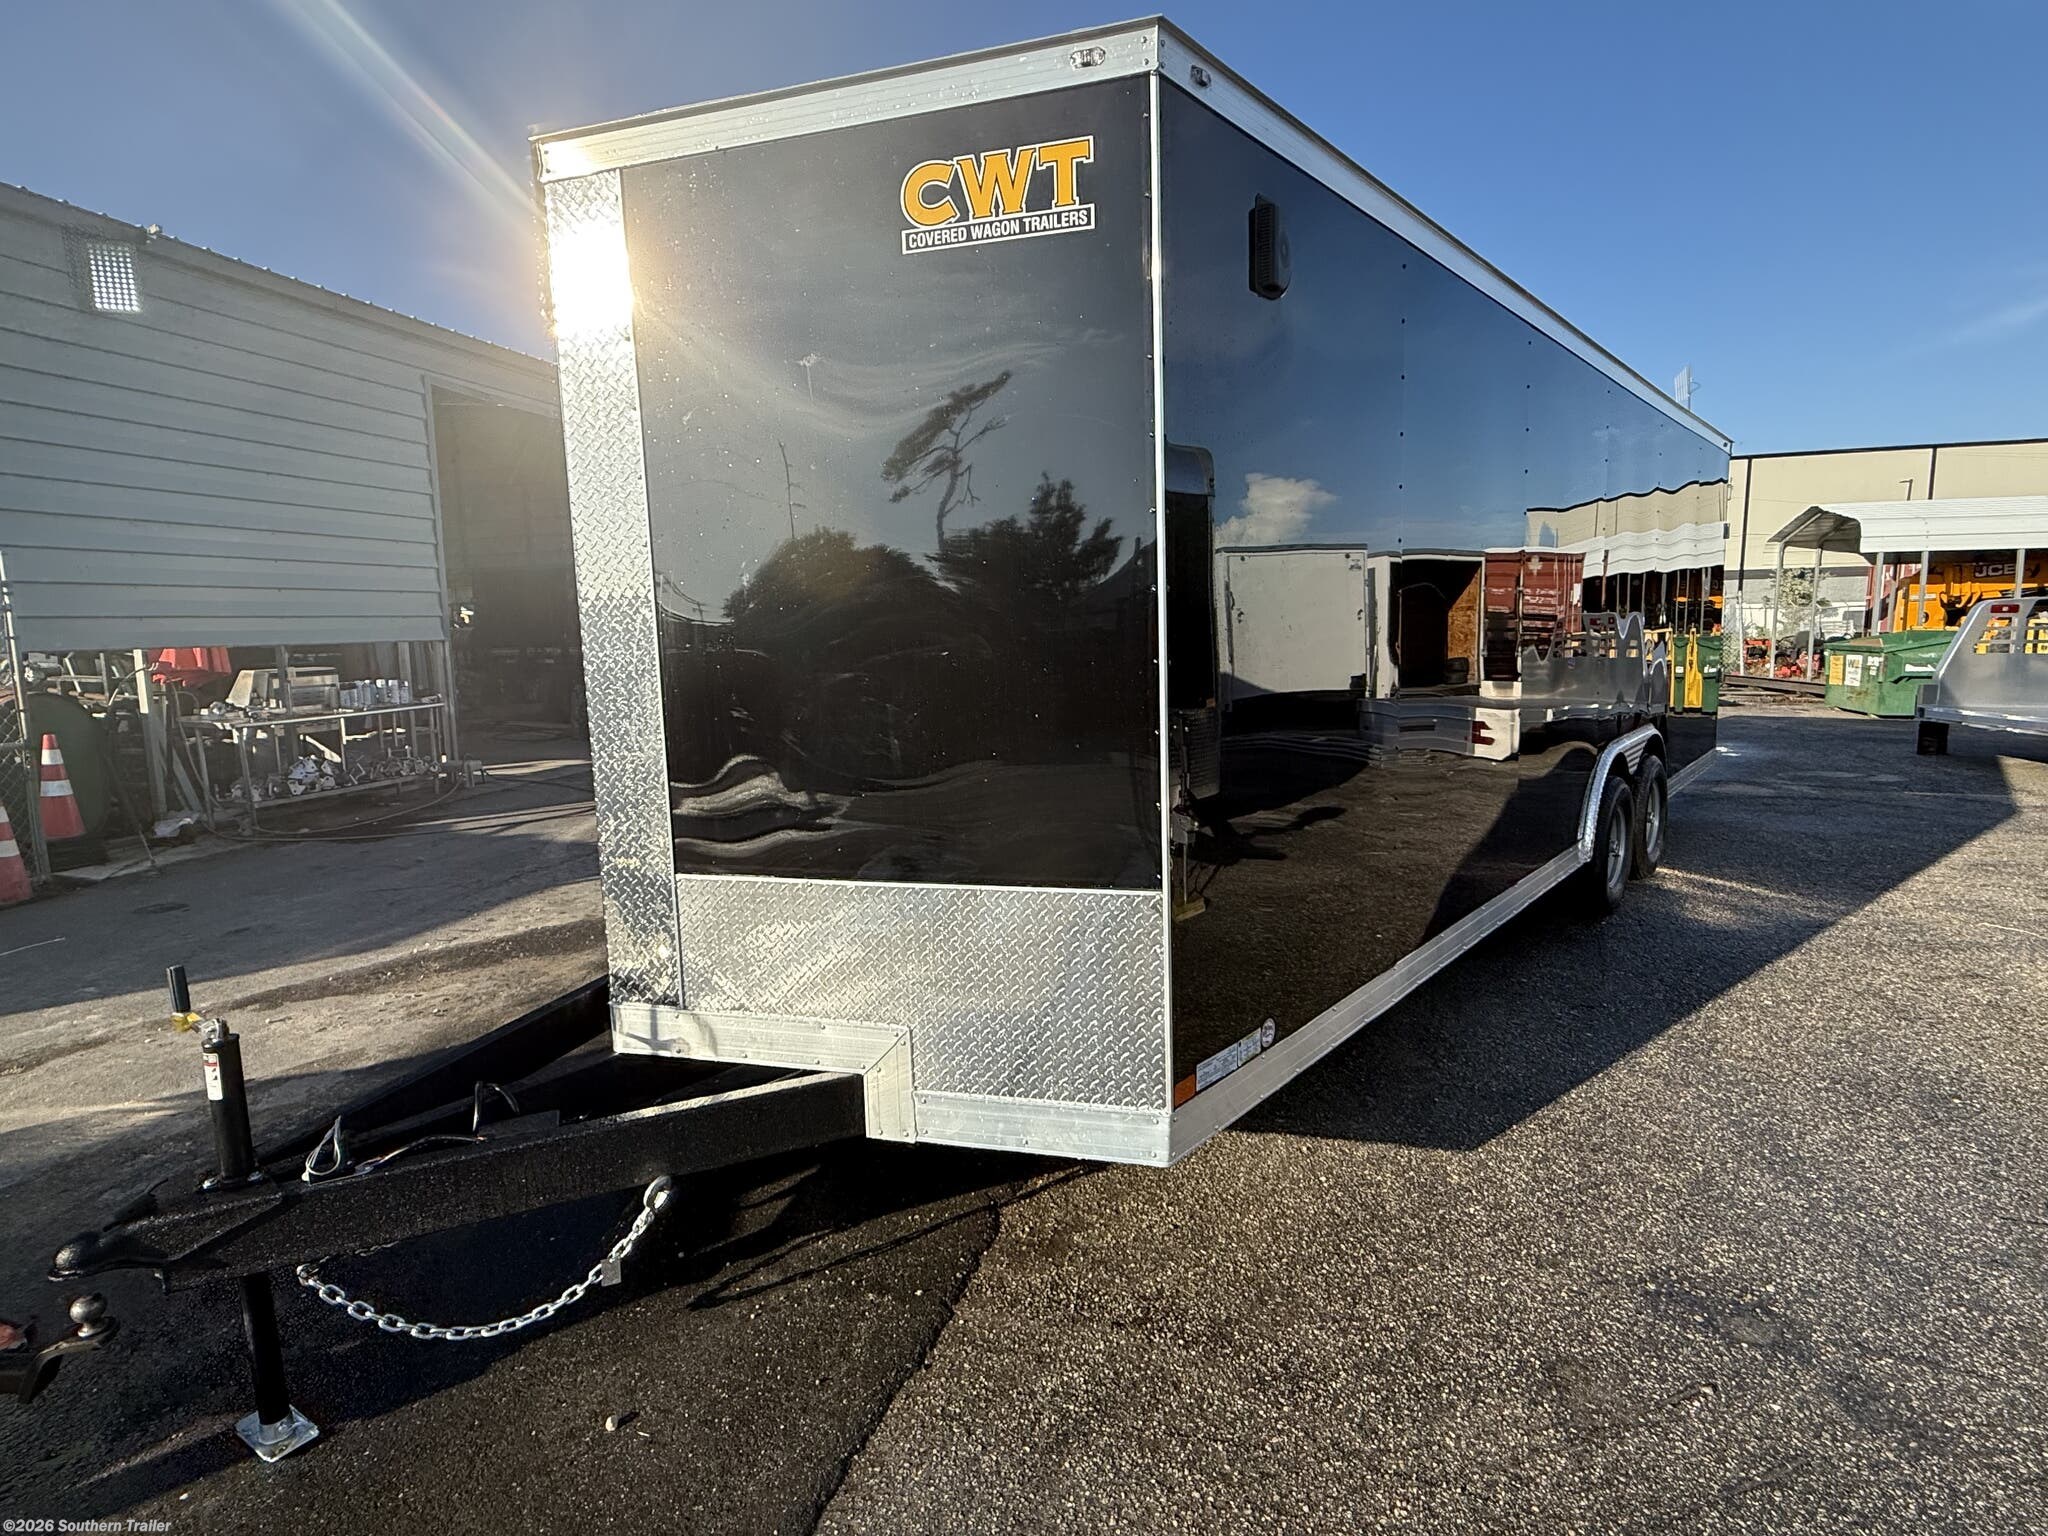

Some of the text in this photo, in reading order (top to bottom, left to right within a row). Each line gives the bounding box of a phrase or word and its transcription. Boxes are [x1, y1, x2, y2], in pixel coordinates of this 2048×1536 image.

[902, 138, 1092, 228] CWT
[908, 209, 1089, 249] COVERED WAGON TRAILERS
